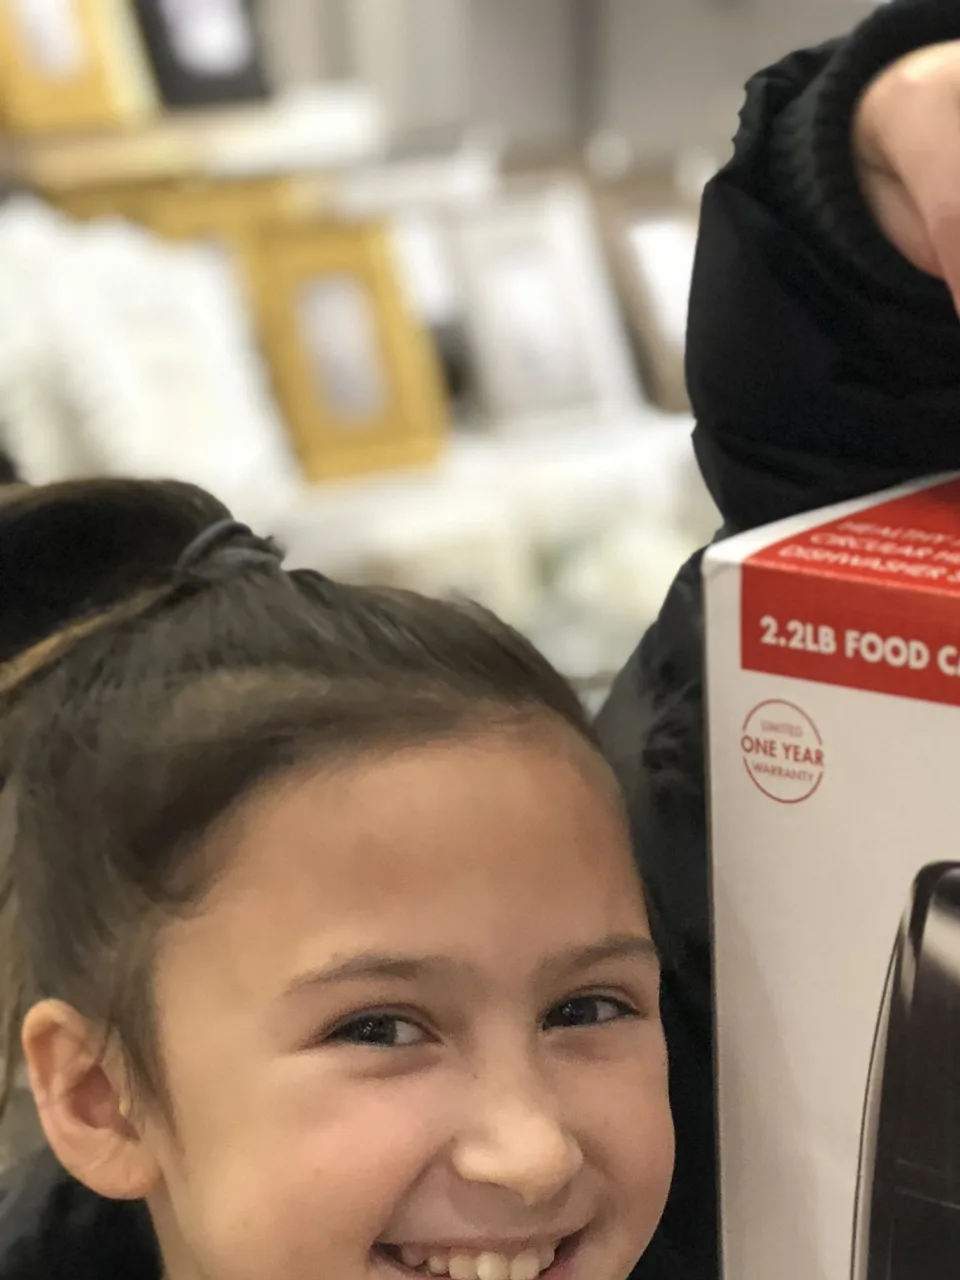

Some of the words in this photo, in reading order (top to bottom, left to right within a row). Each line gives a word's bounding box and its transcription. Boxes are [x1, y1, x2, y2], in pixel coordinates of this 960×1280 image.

[759, 615, 837, 654] 2.2LB
[845, 632, 929, 671] FOOD
[740, 735, 777, 758] ONE
[782, 742, 824, 767] YEAR
